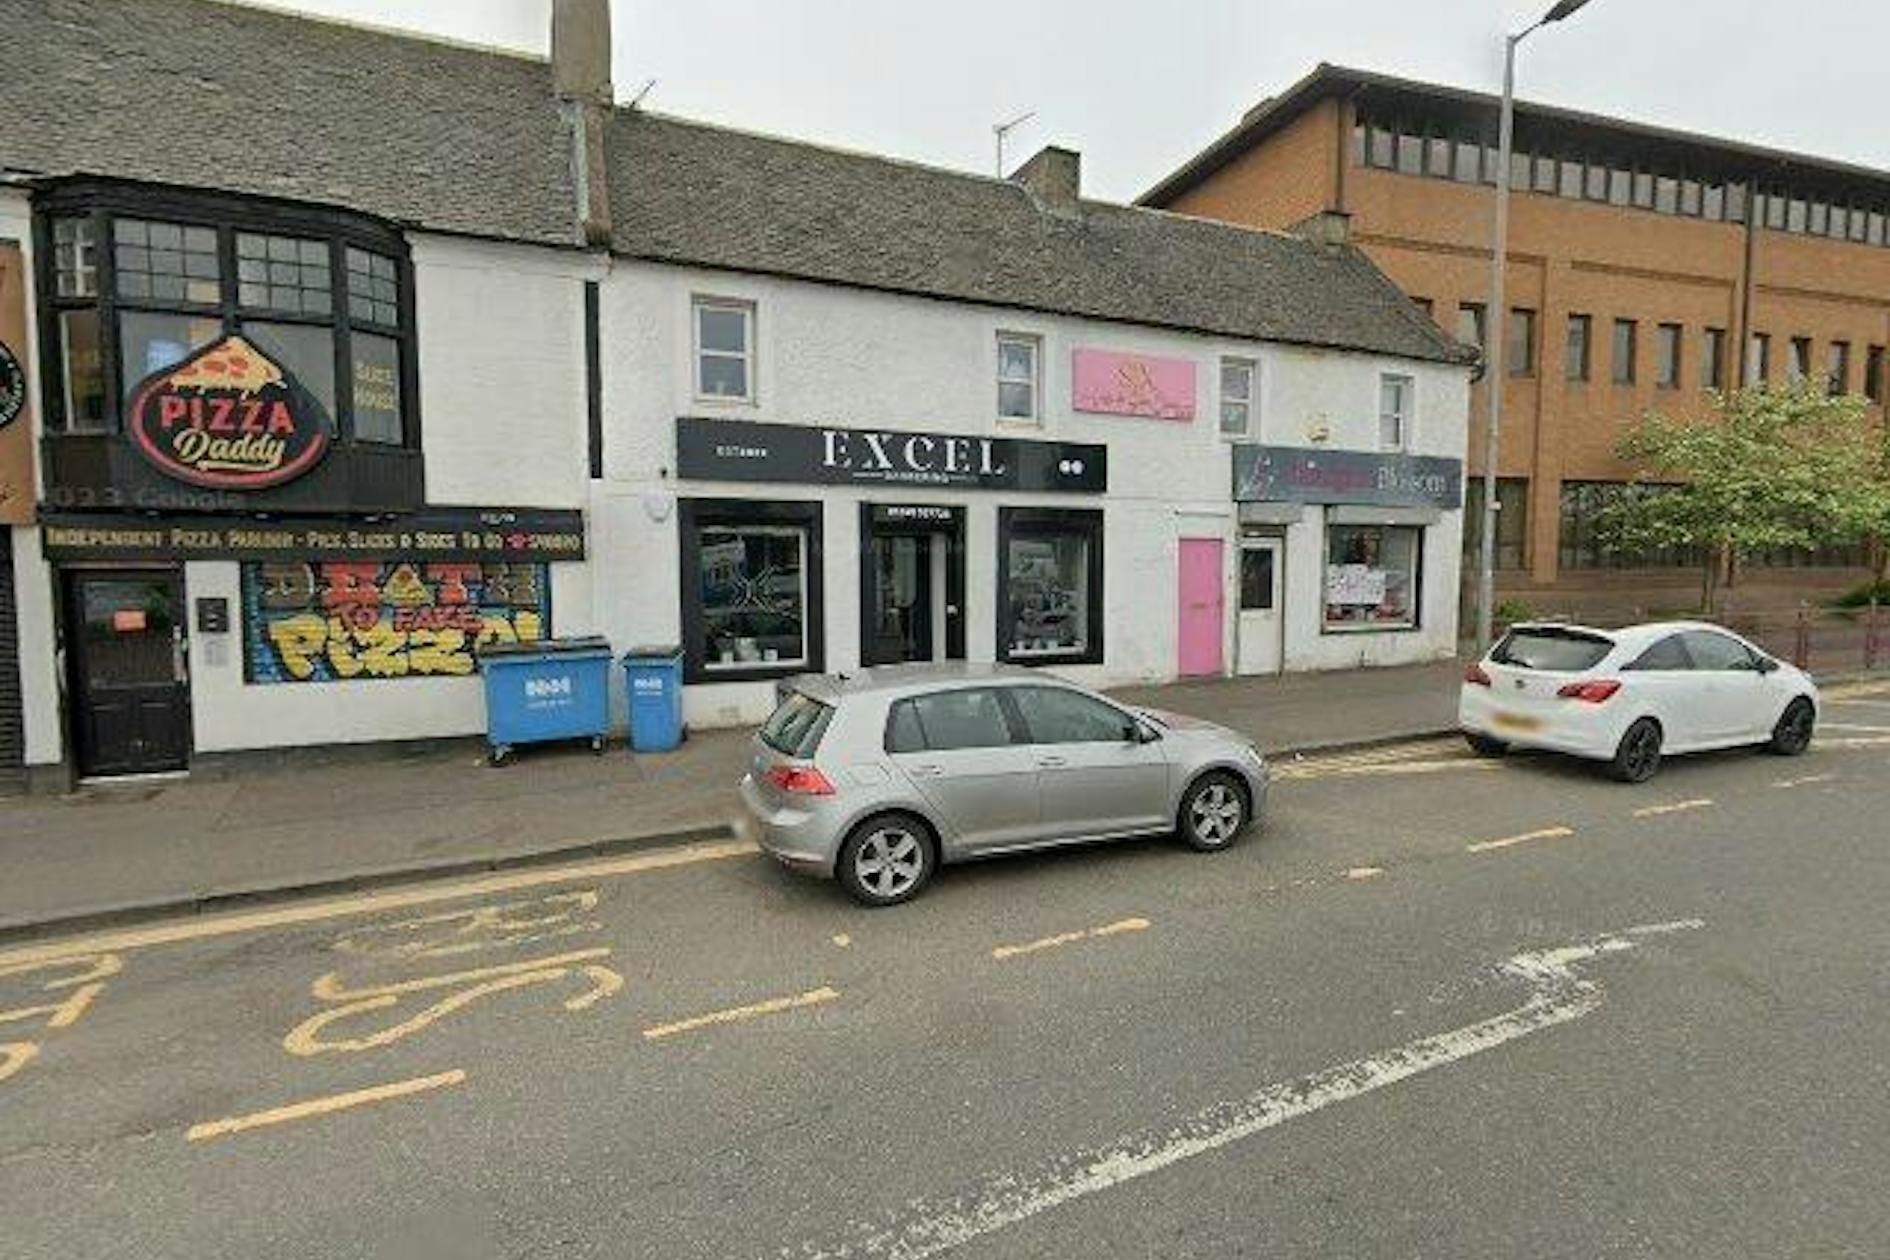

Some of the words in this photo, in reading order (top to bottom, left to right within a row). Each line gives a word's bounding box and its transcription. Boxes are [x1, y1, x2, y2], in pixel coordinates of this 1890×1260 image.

[160, 395, 295, 434] PIZZA
[173, 428, 285, 470] Daddy
[822, 430, 1005, 475] EXCEL
[171, 528, 223, 549] PIZZA
